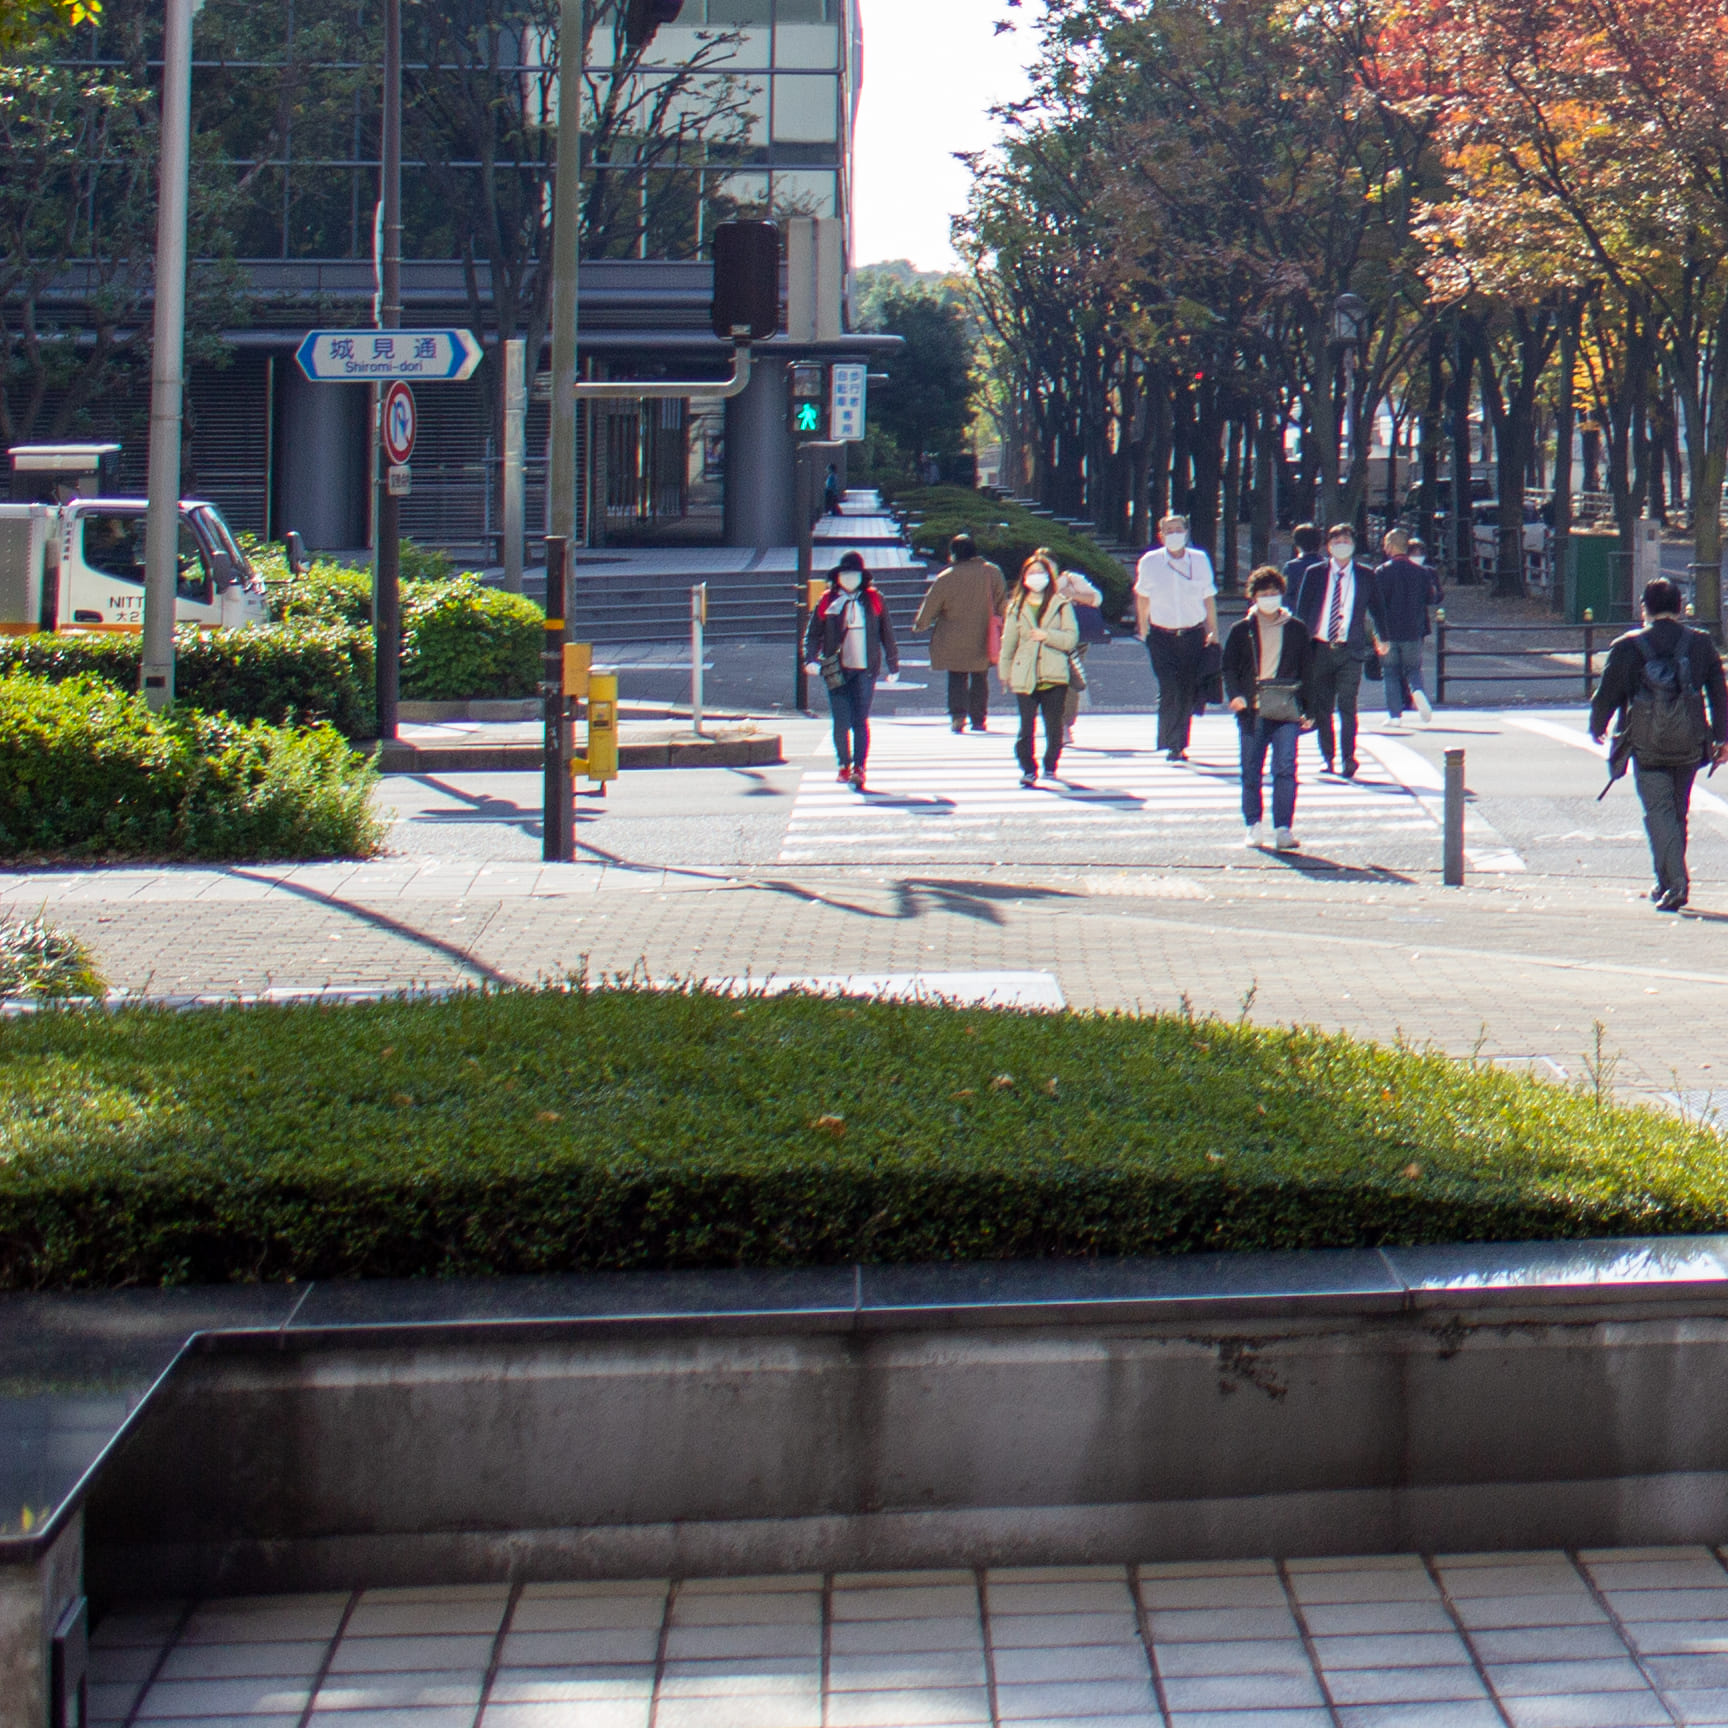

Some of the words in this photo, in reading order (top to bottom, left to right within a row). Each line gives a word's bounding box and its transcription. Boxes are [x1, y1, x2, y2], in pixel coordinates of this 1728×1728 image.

[330, 338, 437, 360] 城見通
[346, 361, 424, 373] Shiromi-dori
